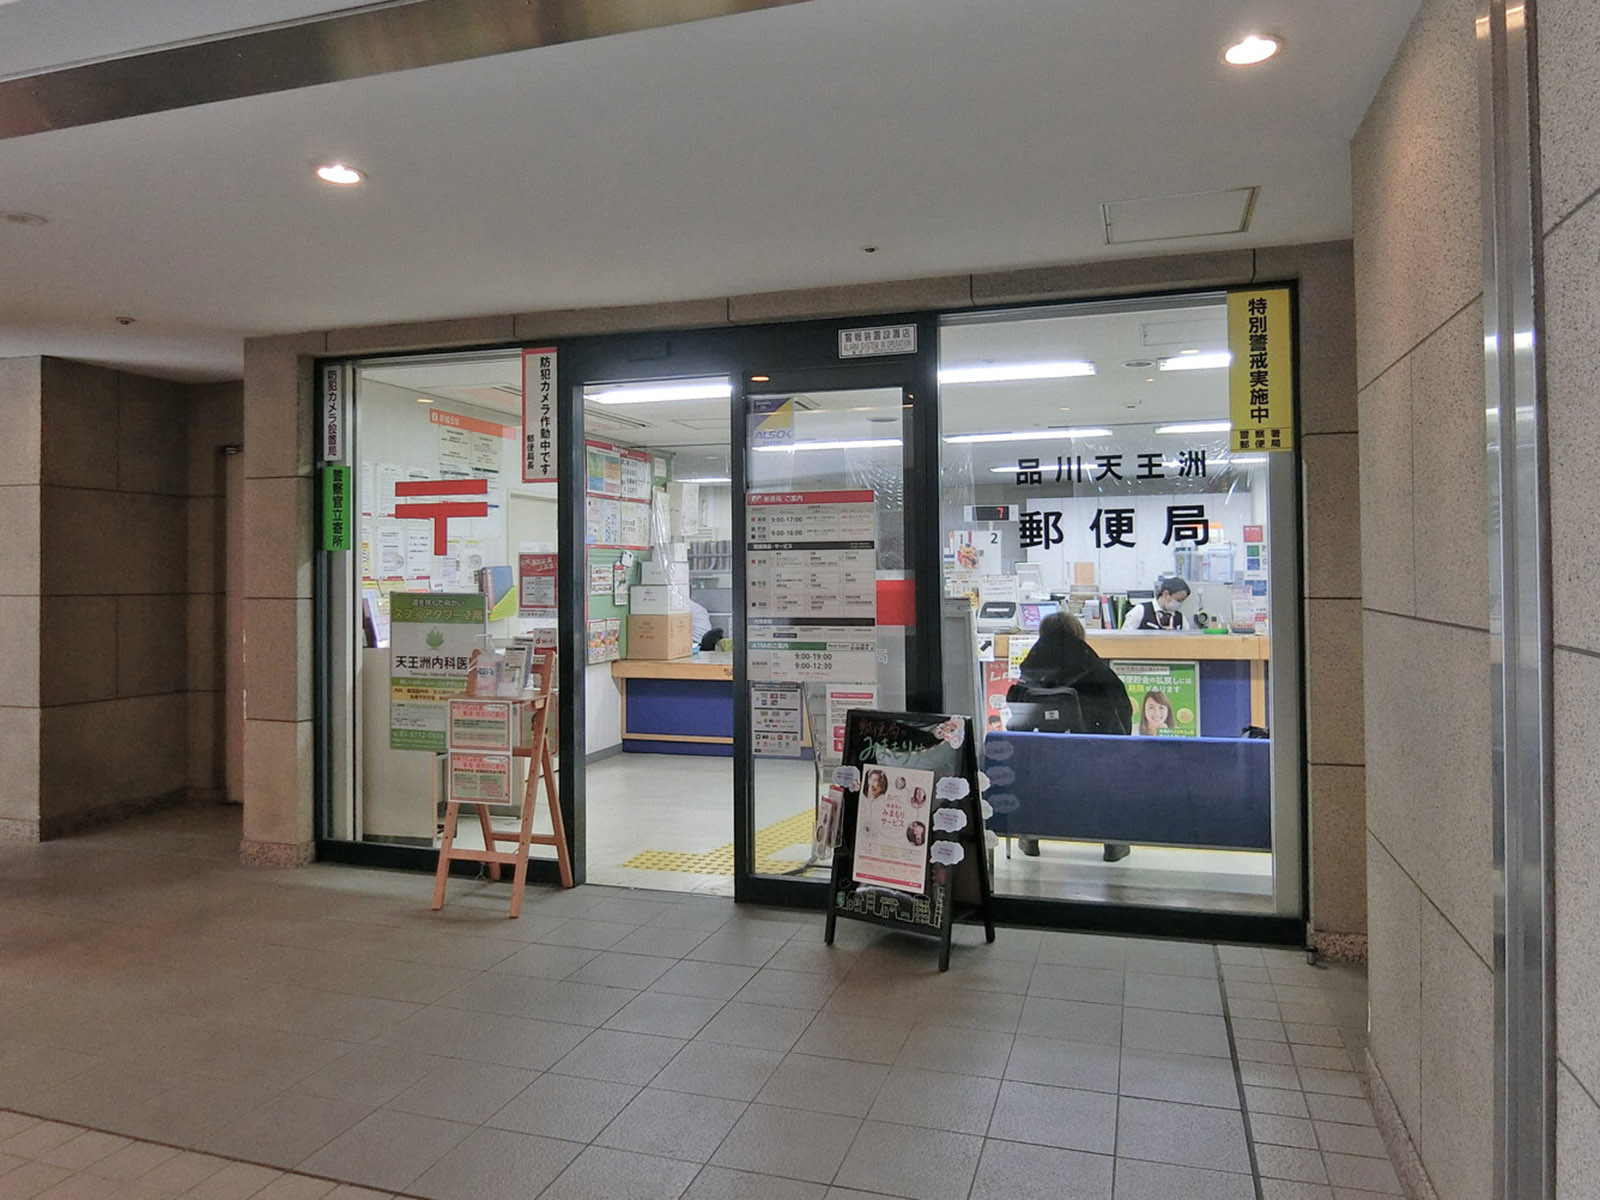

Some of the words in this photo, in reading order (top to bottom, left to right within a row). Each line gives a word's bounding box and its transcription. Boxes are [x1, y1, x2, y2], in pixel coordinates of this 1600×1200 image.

[1247, 297, 1269, 424] 特別警戒実施中
[539, 356, 551, 476] 防犯カメラ作動中です
[754, 430, 792, 440] ALSOK
[1239, 429, 1281, 440] 警察署
[1239, 439, 1281, 450] 郵便局
[526, 434, 535, 470] 郵便局長
[1016, 450, 1206, 486] 品川天王洲
[332, 469, 343, 548] 警察官立寄所
[1018, 504, 1209, 550] 郵便局
[990, 532, 998, 544] 2
[794, 652, 833, 660] 9:00-19:00
[395, 655, 472, 670] 天王洲内科医
[794, 662, 833, 670] 9:00-12:30
[881, 809, 905, 819] みまもり
[881, 818, 905, 828] サービス
